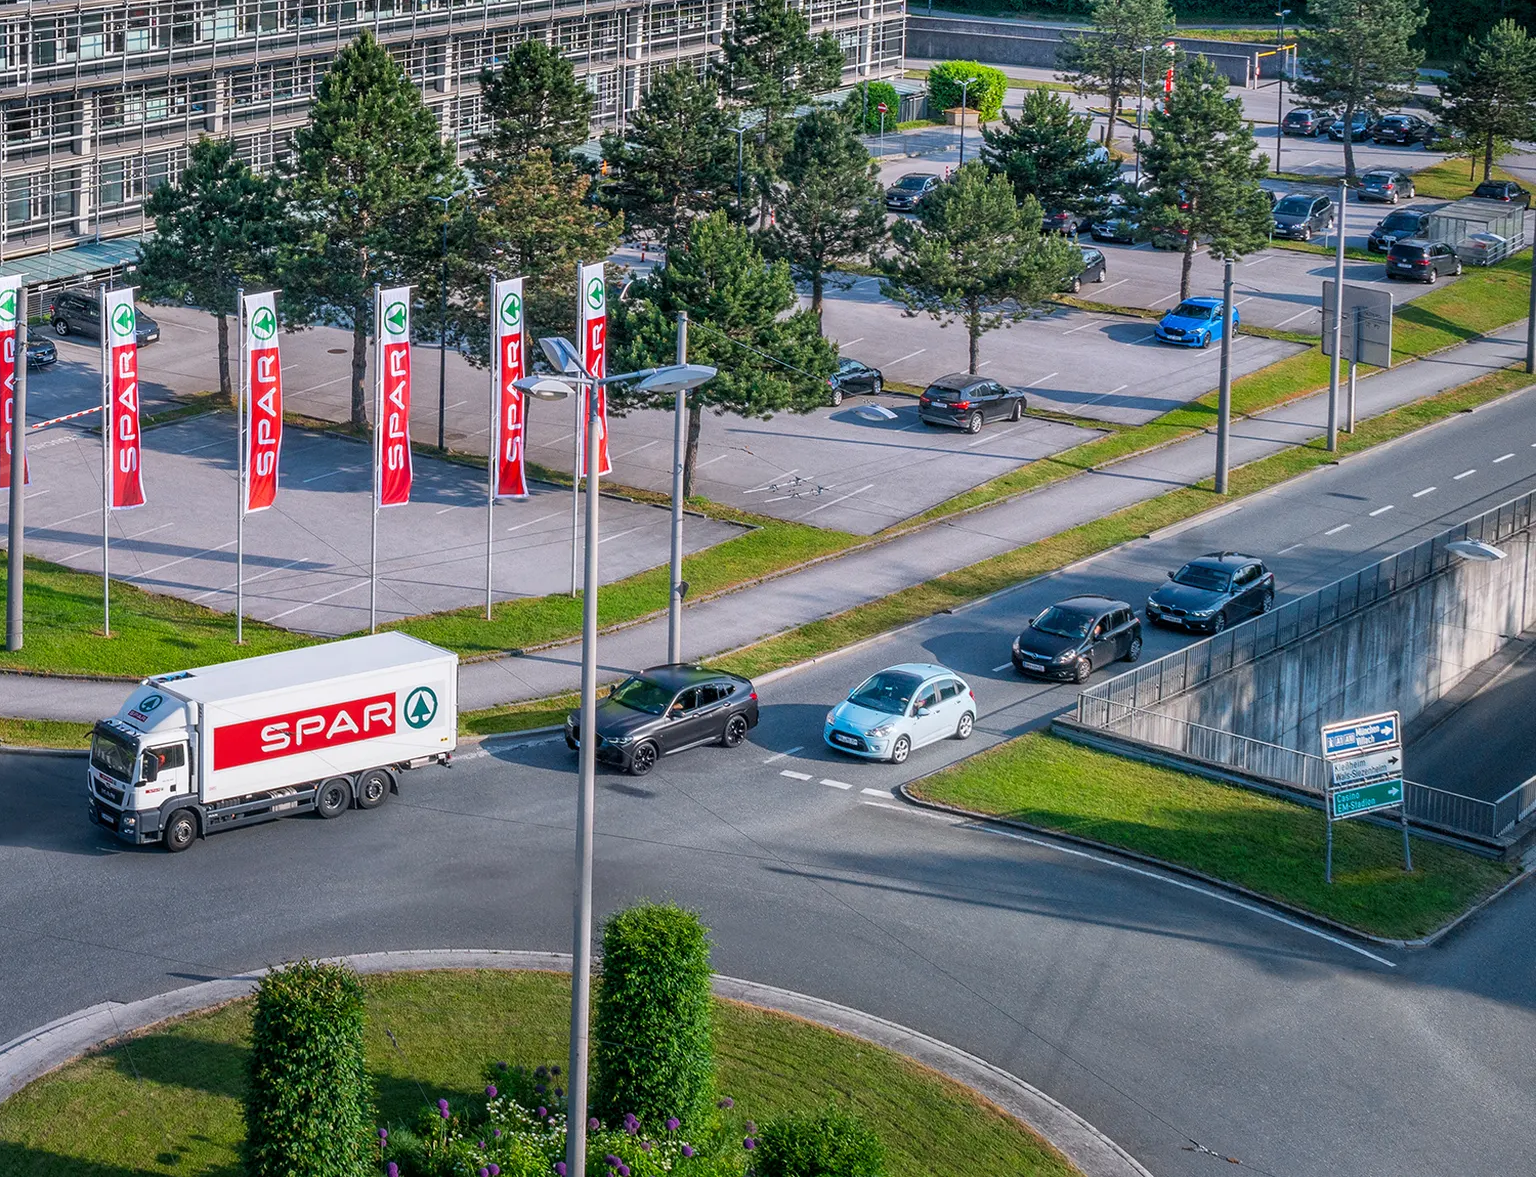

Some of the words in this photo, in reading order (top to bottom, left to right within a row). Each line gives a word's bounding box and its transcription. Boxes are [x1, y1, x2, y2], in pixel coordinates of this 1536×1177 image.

[118, 350, 137, 473] SPAR
[256, 354, 277, 476] SPAR
[388, 348, 407, 471] SPAR
[129, 710, 147, 721] SPAR
[260, 701, 393, 753] SPAR
[1355, 725, 1380, 736] München
[1356, 734, 1375, 746] Villach
[1336, 791, 1360, 803] Casino
[1337, 798, 1376, 813] EM-Stadion
